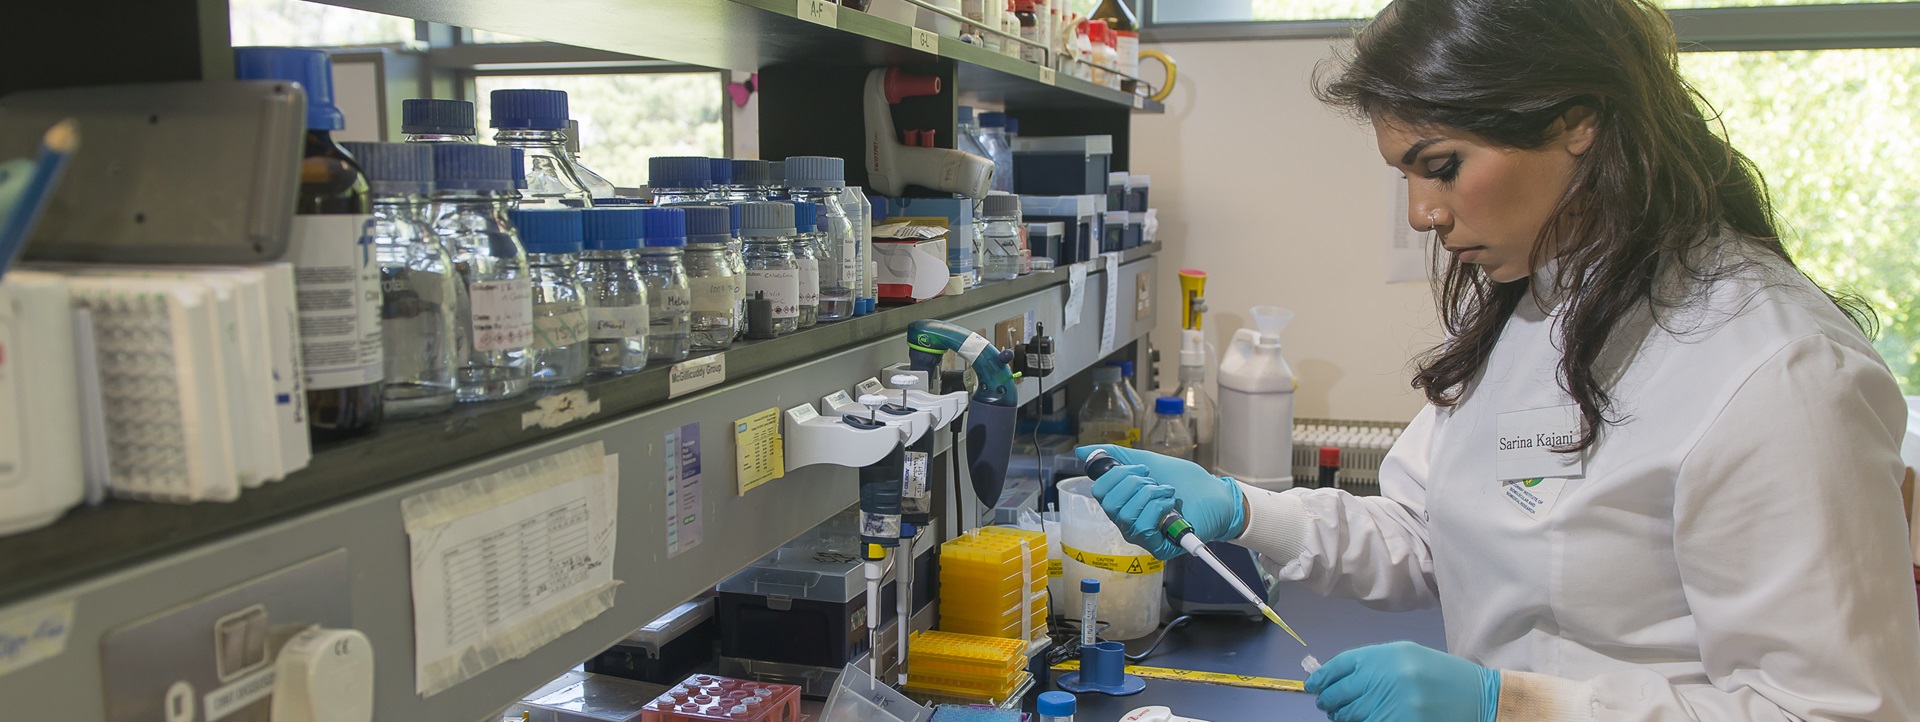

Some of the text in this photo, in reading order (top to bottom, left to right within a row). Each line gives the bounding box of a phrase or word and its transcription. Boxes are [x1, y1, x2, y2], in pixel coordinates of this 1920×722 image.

[810, 0, 824, 18] A-F
[919, 32, 930, 48] G-L
[705, 364, 722, 375] Group
[1499, 431, 1574, 451] Sarina Kajani
[1091, 560, 1118, 568] RADIOACTIVE
